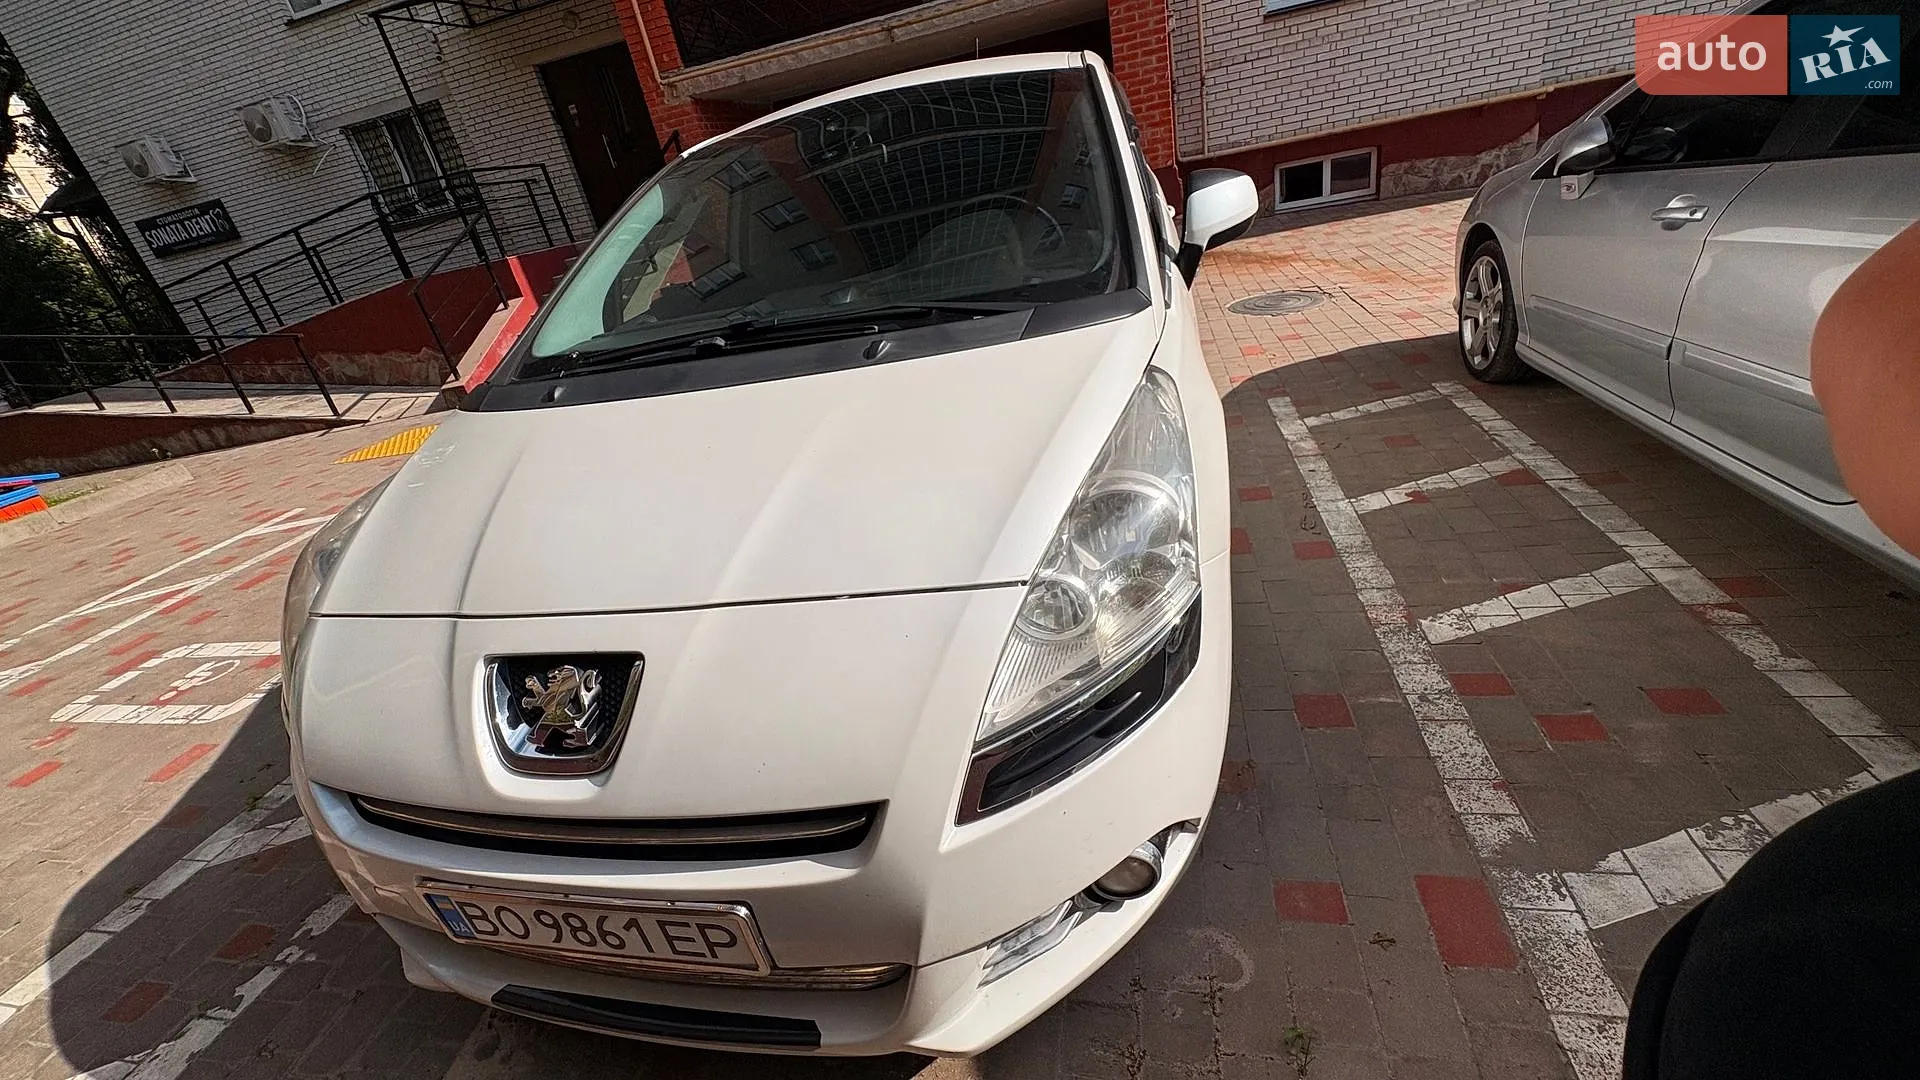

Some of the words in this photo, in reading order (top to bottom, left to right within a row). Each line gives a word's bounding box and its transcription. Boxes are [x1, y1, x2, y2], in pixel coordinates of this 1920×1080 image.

[145, 223, 190, 248] SONATA
[184, 214, 217, 238] DENT
[449, 920, 469, 933] UA
